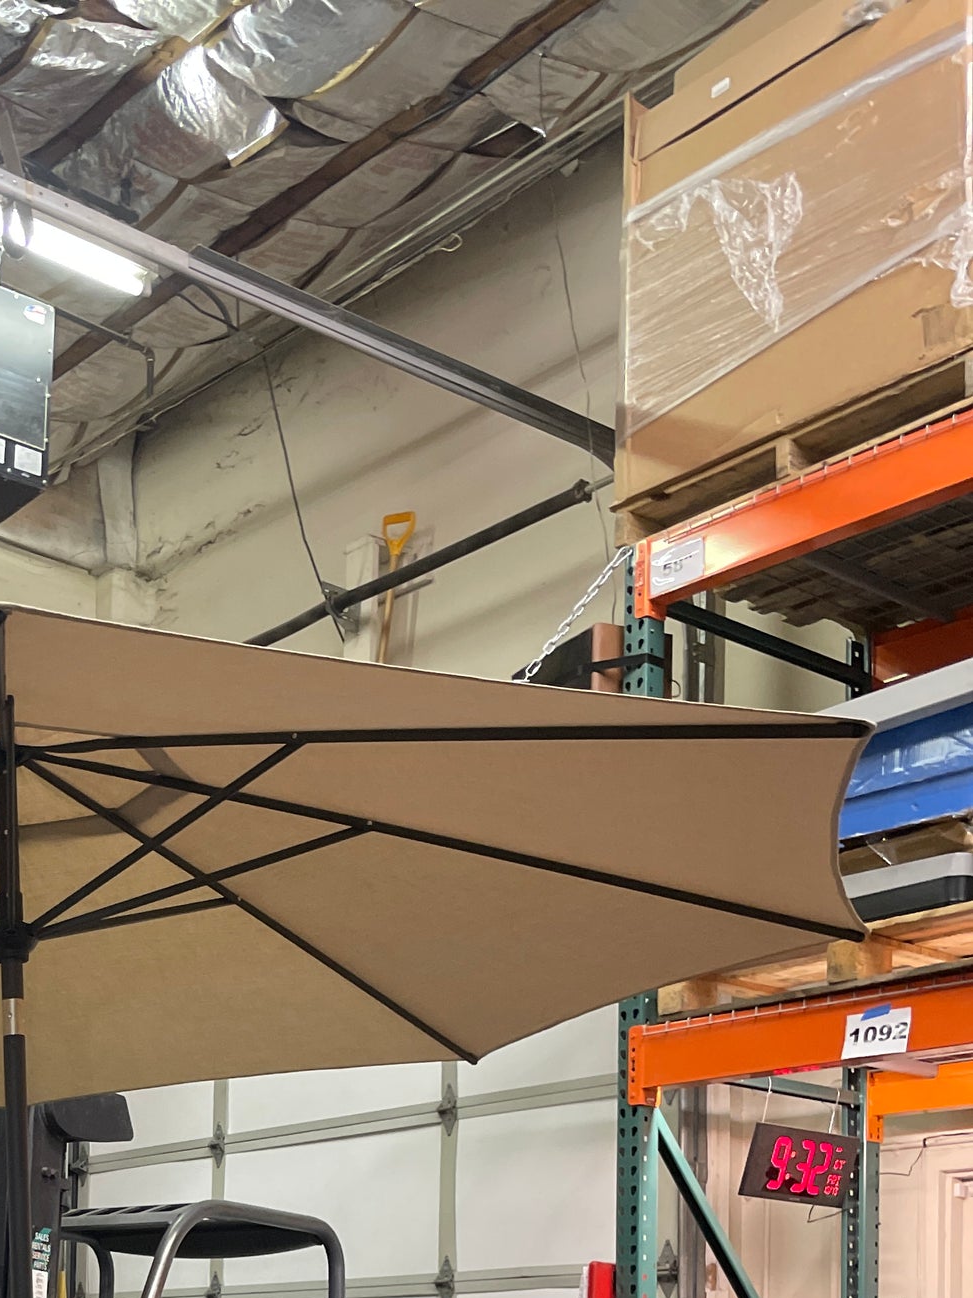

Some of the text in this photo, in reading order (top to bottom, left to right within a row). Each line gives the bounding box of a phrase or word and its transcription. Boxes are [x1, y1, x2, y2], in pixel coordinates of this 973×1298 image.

[849, 1022, 909, 1043] 1092
[766, 1136, 833, 1195] 9:32
[35, 1232, 50, 1242] SALES
[32, 1241, 51, 1252] RENTALS
